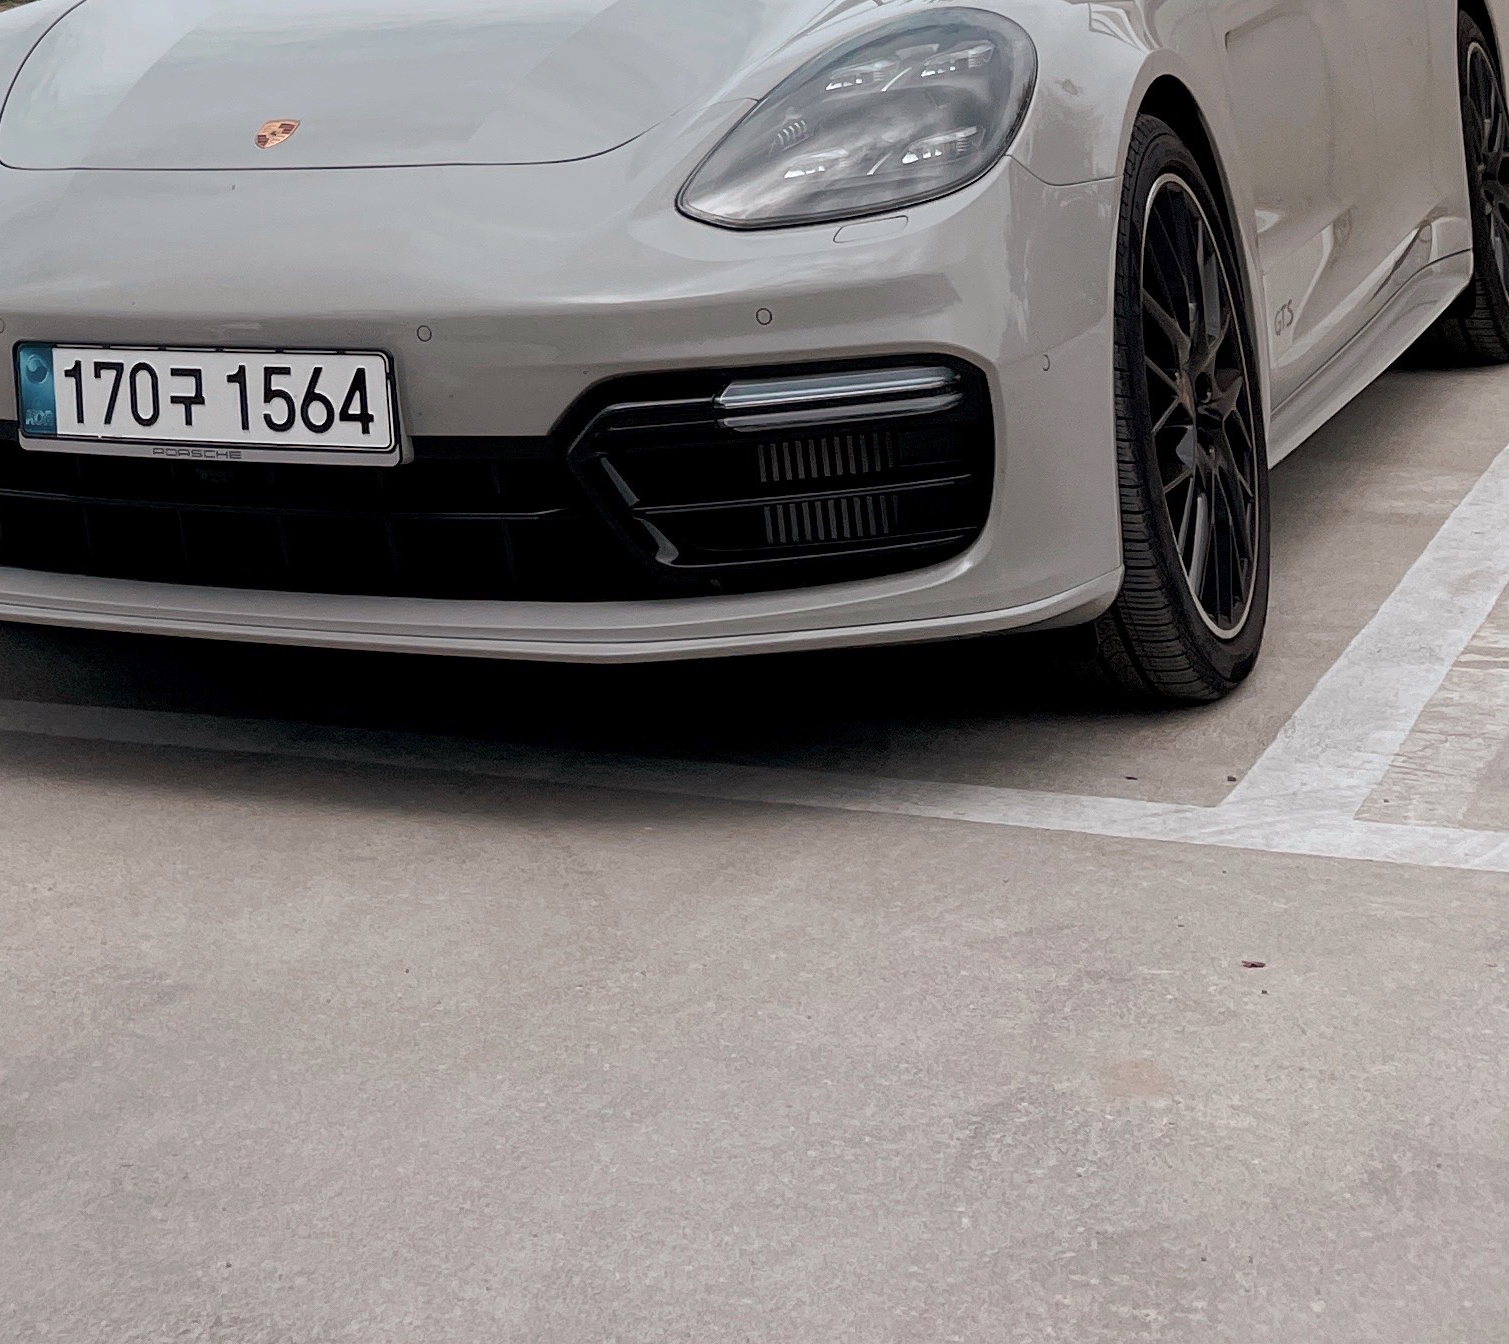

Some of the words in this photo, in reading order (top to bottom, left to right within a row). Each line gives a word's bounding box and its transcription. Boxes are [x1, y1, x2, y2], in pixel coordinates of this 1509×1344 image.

[1274, 299, 1294, 337] GTS
[225, 364, 376, 435] 1564
[152, 447, 242, 460] PORSCHE
